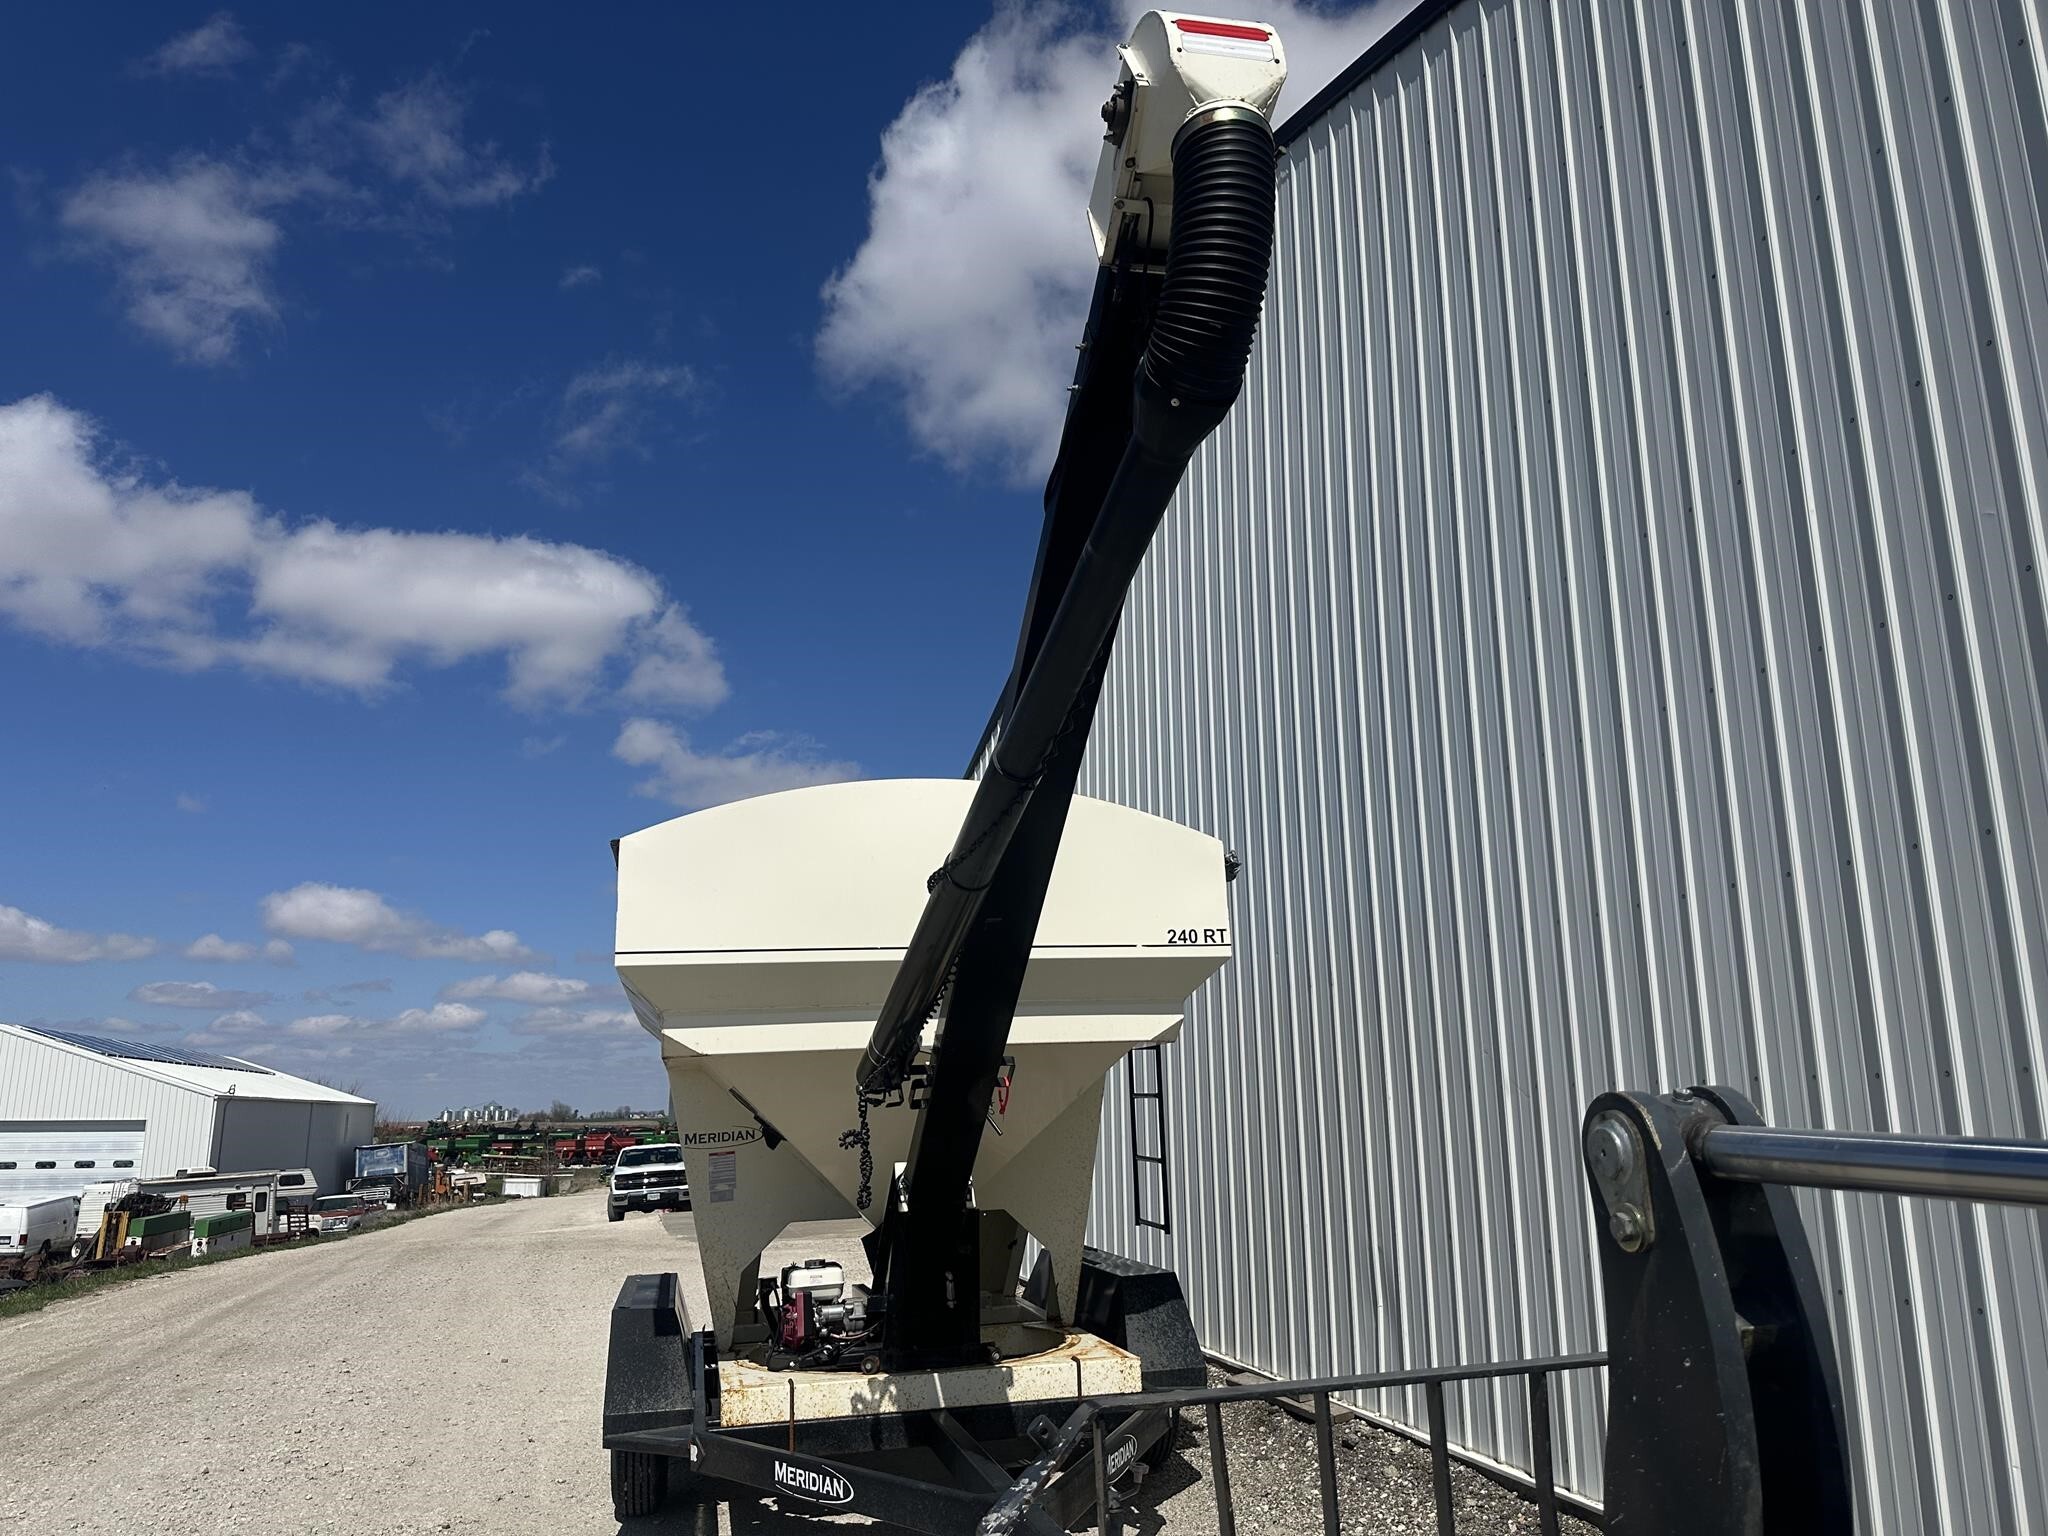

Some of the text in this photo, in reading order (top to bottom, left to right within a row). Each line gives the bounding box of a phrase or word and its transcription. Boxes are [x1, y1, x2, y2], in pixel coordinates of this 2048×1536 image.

[1167, 928, 1227, 944] 240 RT
[684, 1129, 756, 1145] MERIDIAN
[774, 1460, 845, 1499] MERIDIAN
